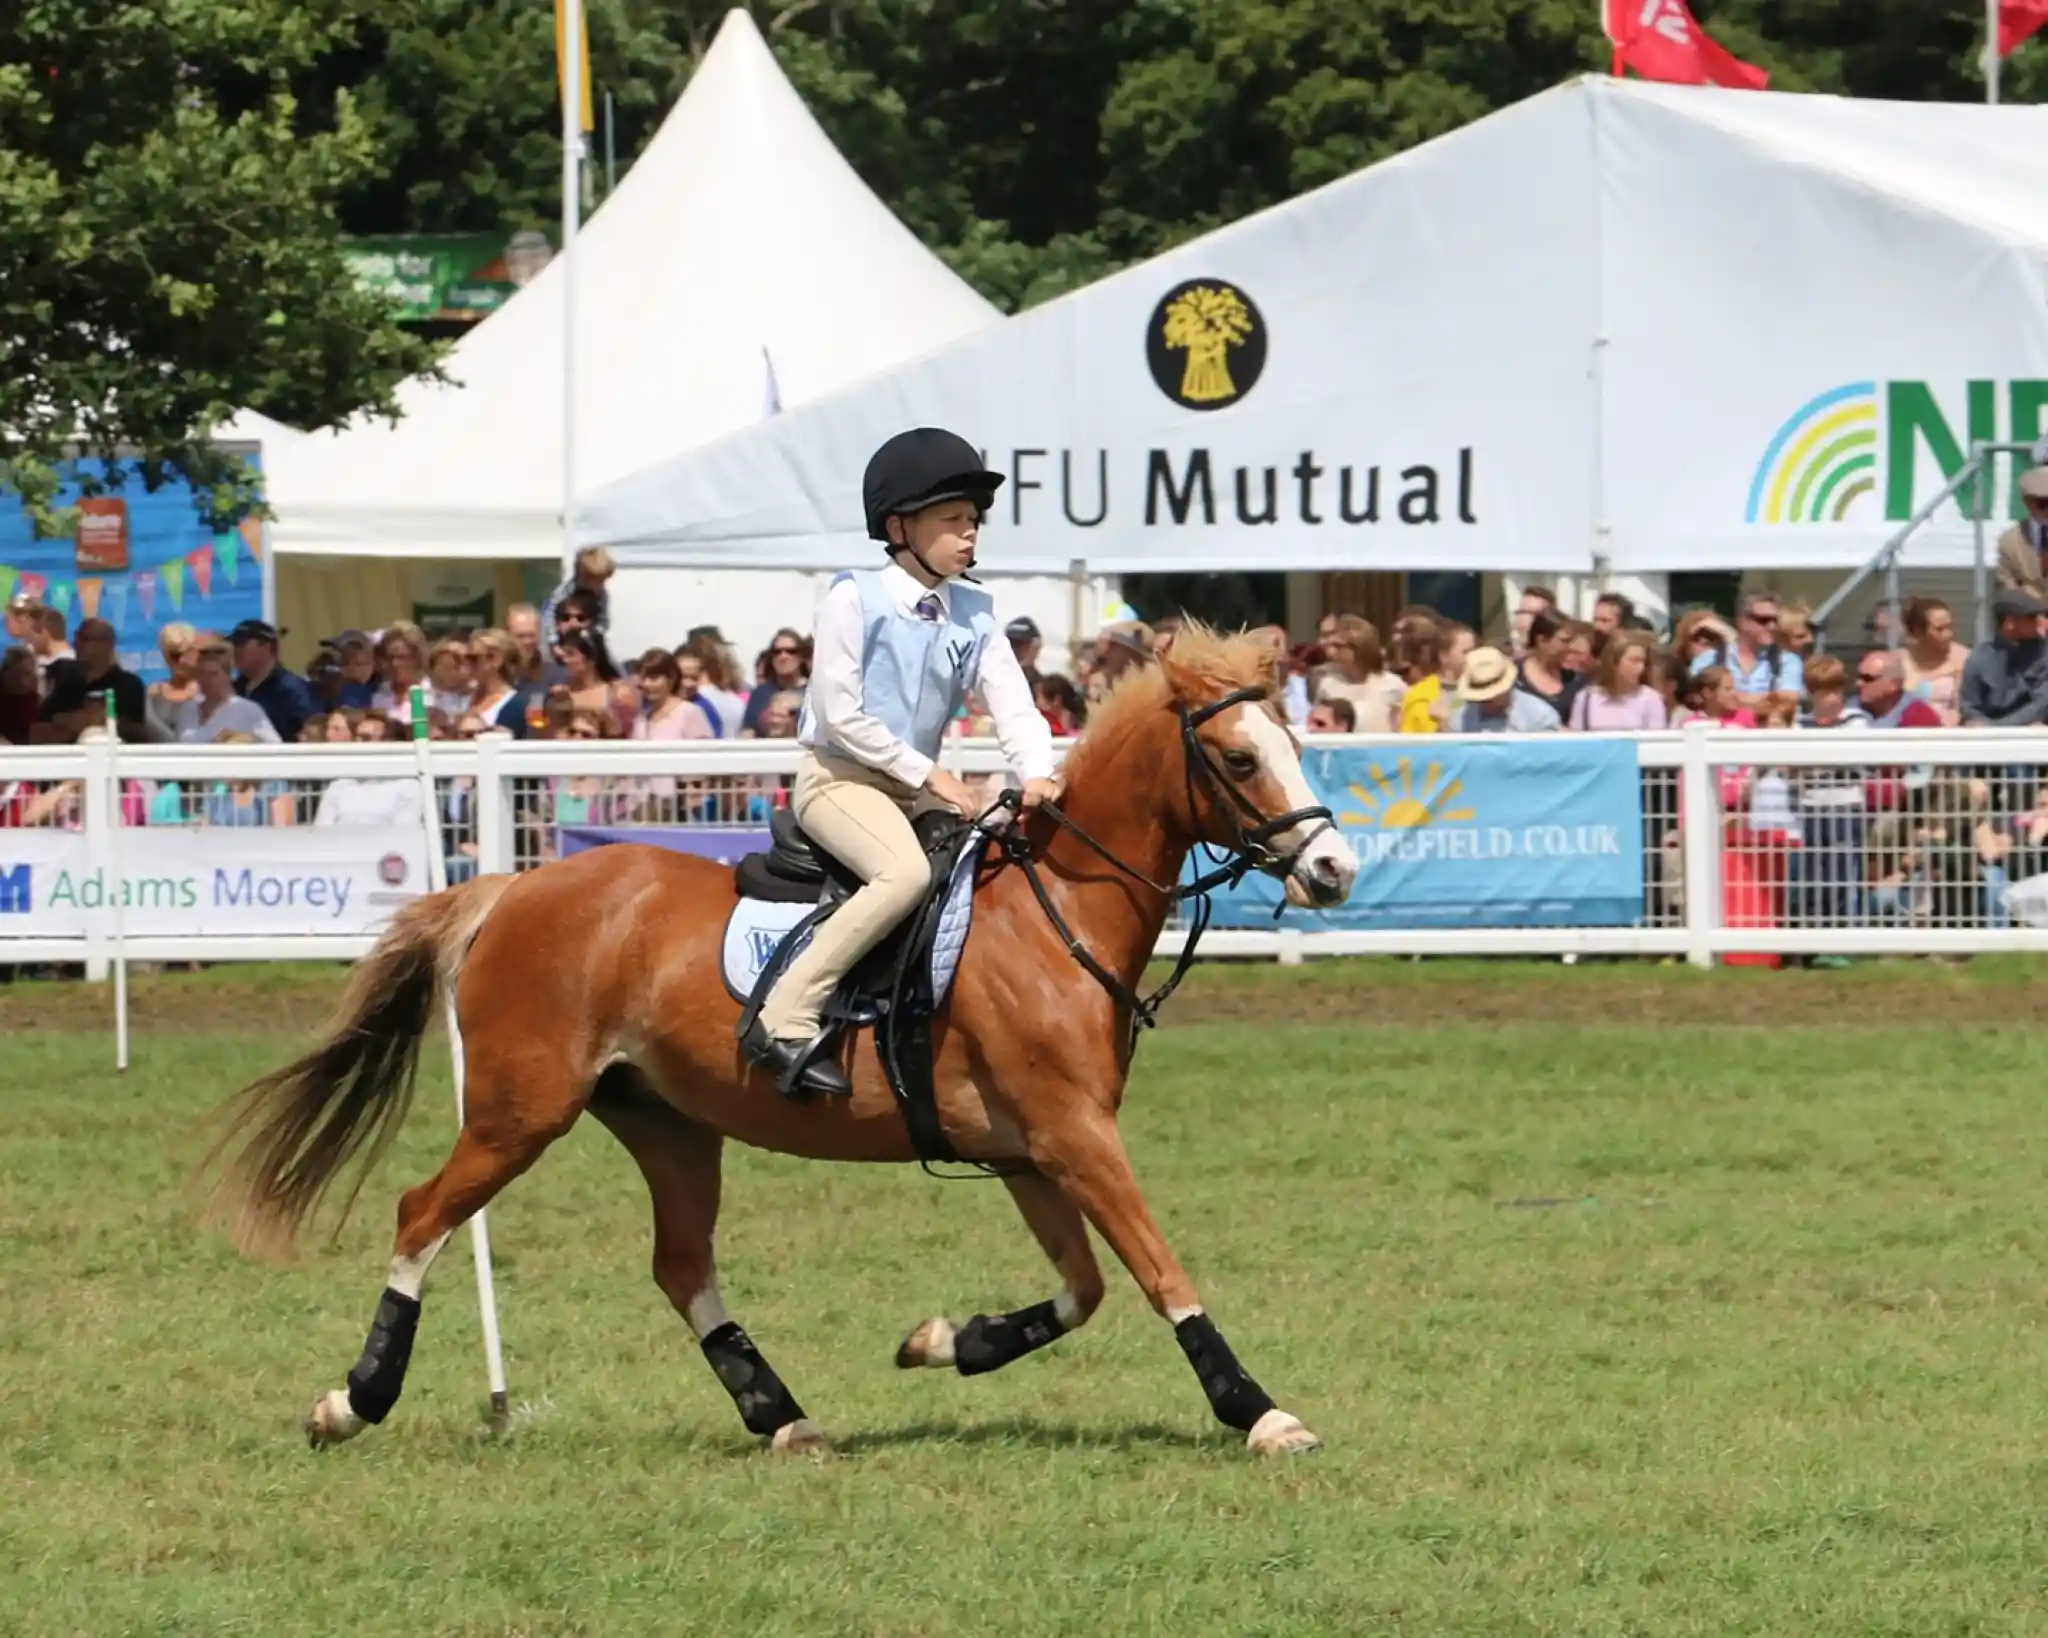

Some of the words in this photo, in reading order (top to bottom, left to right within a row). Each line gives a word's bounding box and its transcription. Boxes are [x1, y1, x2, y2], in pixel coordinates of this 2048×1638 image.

[979, 448, 1108, 528] FU
[1144, 446, 1478, 526] Mutual
[1346, 824, 1621, 864] OREFIELD.CO.UK
[48, 866, 198, 909] Adams
[213, 867, 352, 918] Morey
